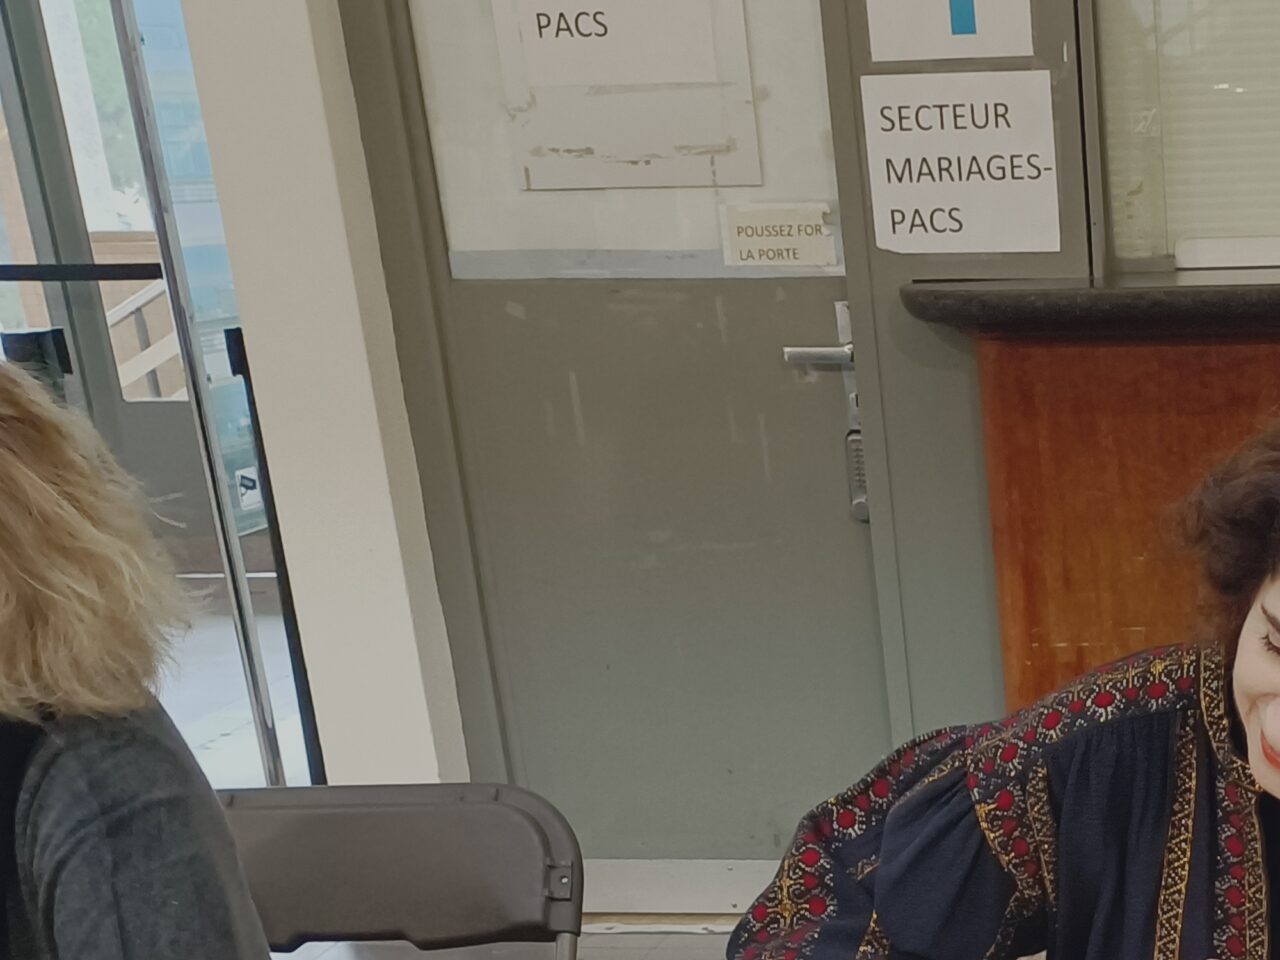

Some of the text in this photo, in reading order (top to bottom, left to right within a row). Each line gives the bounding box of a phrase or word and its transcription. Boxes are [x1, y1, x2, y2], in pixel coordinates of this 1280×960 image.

[535, 11, 609, 39] PACS
[879, 102, 1012, 134] SECTEUR
[885, 153, 1053, 184] MARIAGES-
[737, 224, 794, 238] POUSSEZ
[890, 207, 964, 235] PACS
[739, 247, 799, 261] LA PORTE
